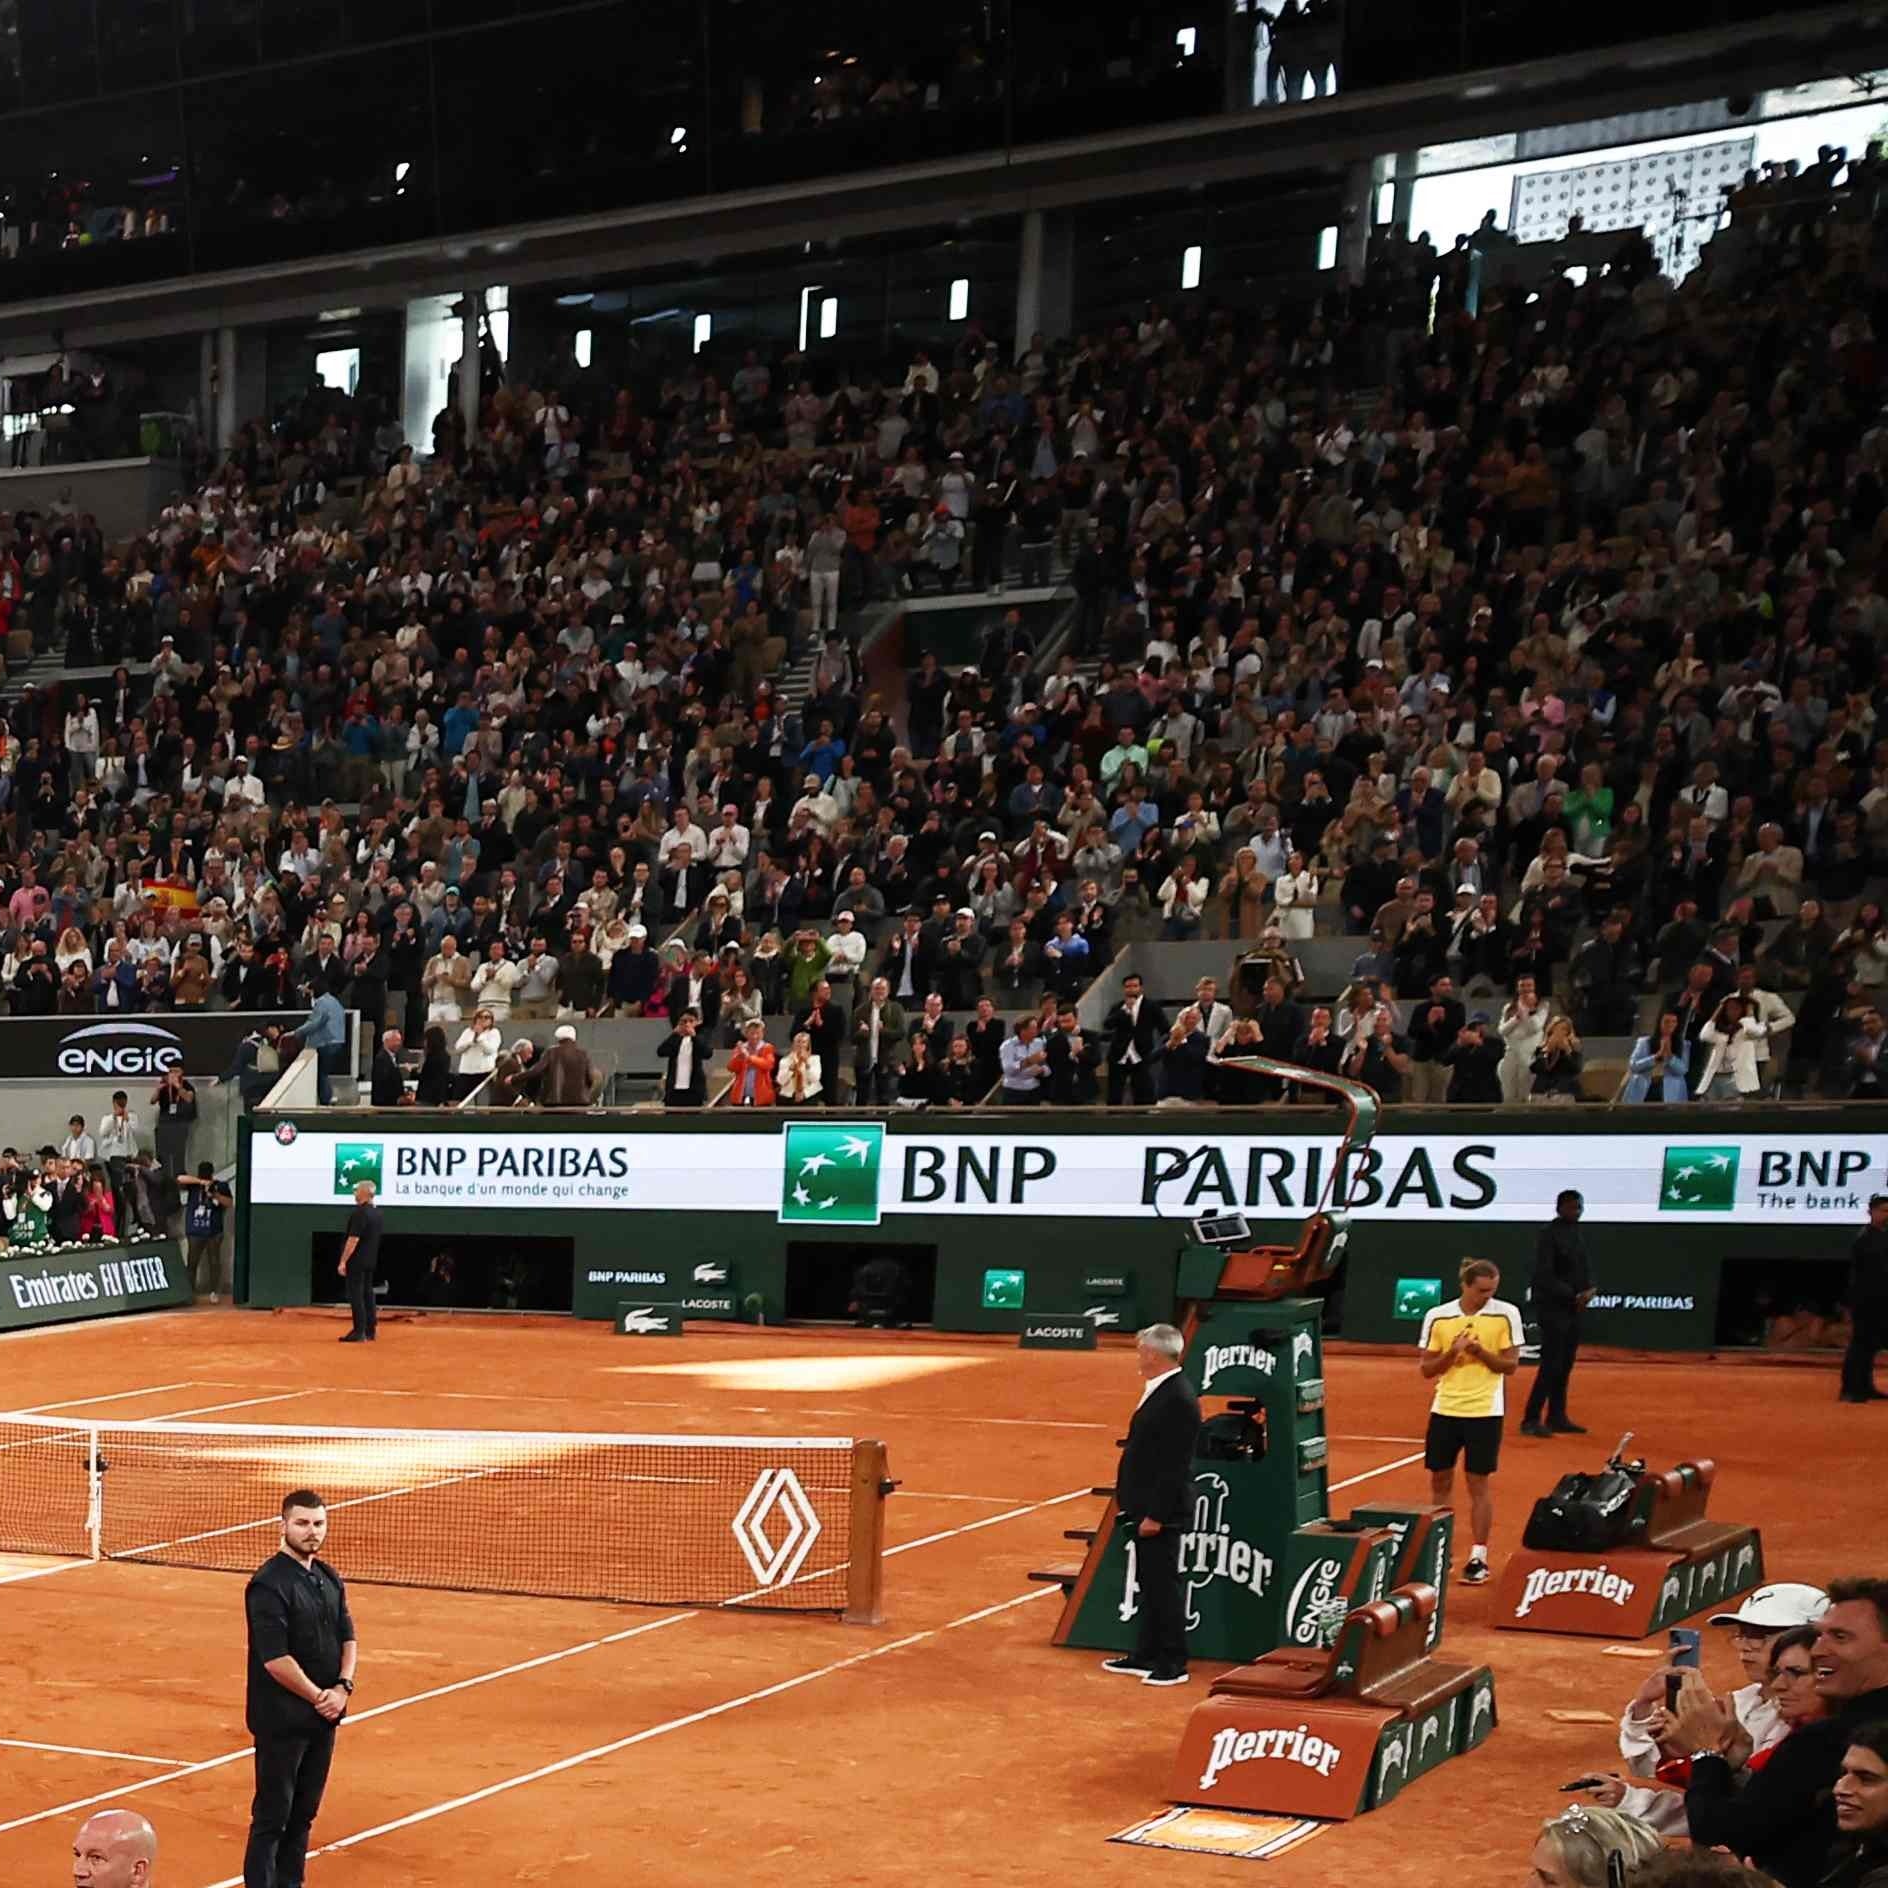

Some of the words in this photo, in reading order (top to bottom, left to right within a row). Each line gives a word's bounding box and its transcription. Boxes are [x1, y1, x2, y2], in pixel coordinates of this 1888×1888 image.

[396, 1147, 467, 1176] BNP
[478, 1147, 629, 1178] PARIBAS
[902, 1146, 1057, 1203] BNP
[1141, 1145, 1497, 1209] PARIBAS
[1759, 1151, 1871, 1188] BNP
[396, 1182, 410, 1194] La
[414, 1182, 463, 1198] banque
[467, 1182, 497, 1195] d'un
[501, 1183, 548, 1196] monde
[552, 1184, 574, 1201] qui
[579, 1184, 629, 1200] change
[1758, 1193, 1795, 1209] The
[1807, 1193, 1859, 1209] bank
[10, 1269, 98, 1309] Emirates
[102, 1262, 124, 1297] FLY
[124, 1256, 168, 1292] BETTER
[588, 1270, 613, 1283] BNP
[615, 1271, 666, 1284] PARIBAS
[681, 1299, 730, 1310] LACOSTE
[1624, 1296, 1694, 1310] PARIBAS
[1026, 1327, 1084, 1339] LACOSTE
[1202, 1345, 1277, 1389] perrier
[1515, 1565, 1634, 1618] perrier
[1199, 1725, 1341, 1790] perrier
